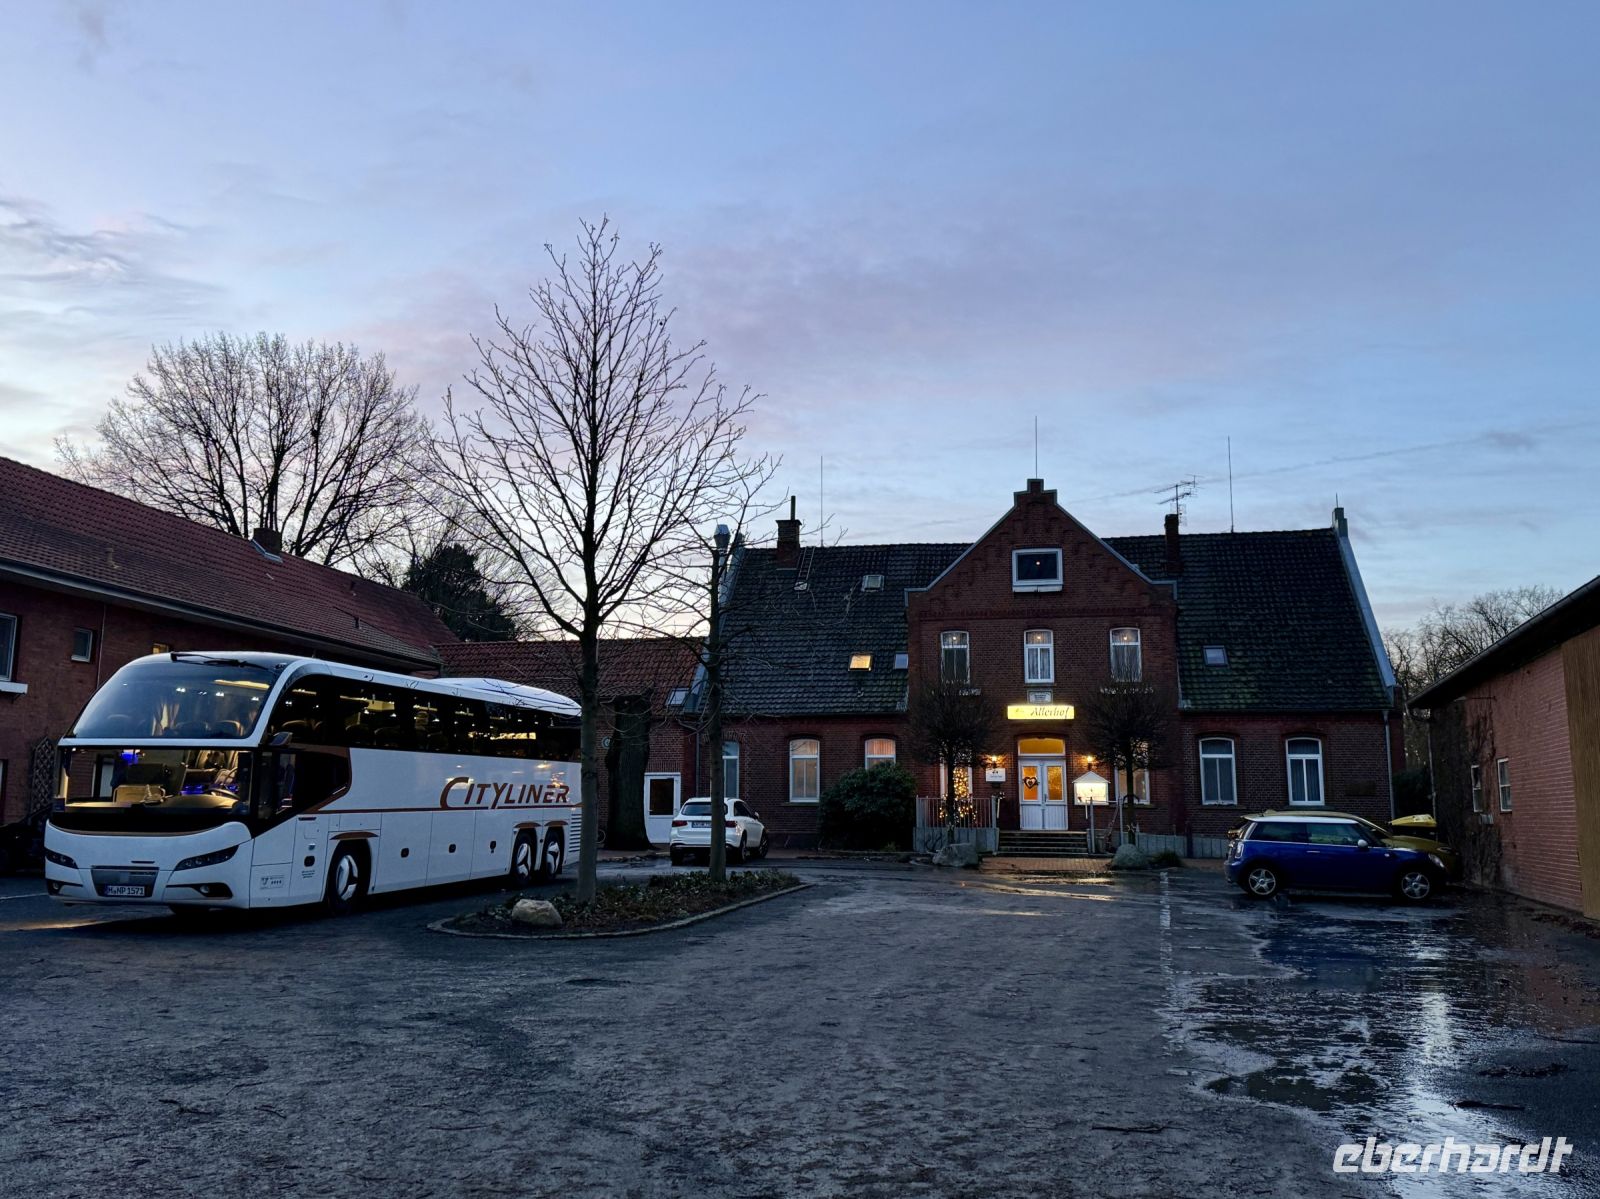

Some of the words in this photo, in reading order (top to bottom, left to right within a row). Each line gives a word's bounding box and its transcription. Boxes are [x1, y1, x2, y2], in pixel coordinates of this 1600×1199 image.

[1030, 707, 1070, 719] Allerhof
[440, 776, 570, 809] CITYLINER
[127, 887, 144, 895] 1571
